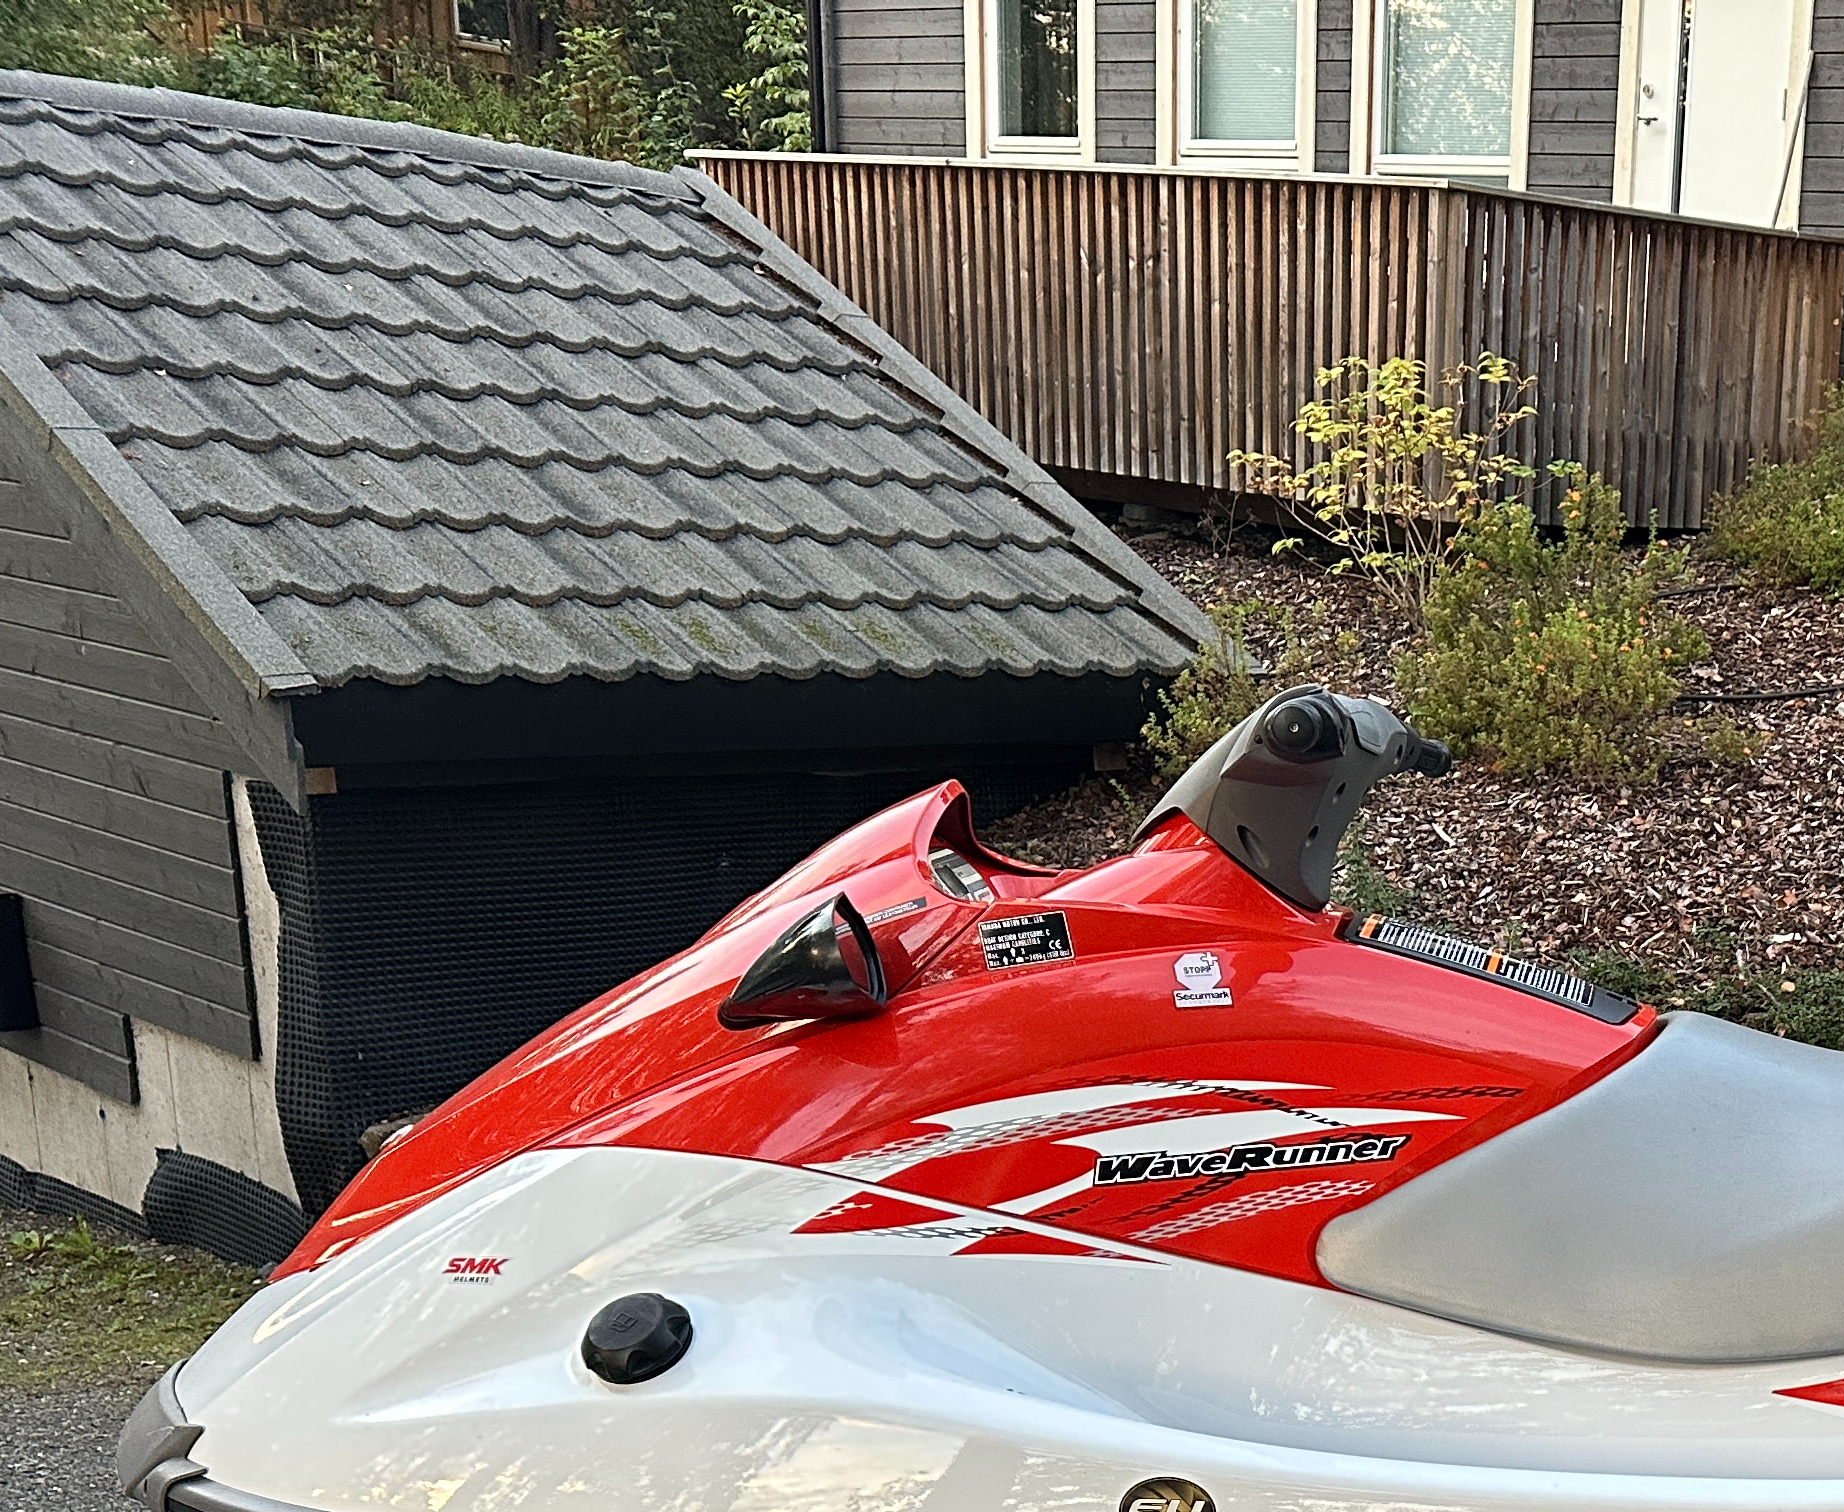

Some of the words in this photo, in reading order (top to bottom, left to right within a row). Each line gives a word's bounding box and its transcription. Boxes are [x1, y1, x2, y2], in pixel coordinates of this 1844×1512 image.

[1176, 991, 1229, 1001] Securmark
[1094, 1134, 1410, 1185] WaveRunner
[442, 1258, 511, 1274] SMK
